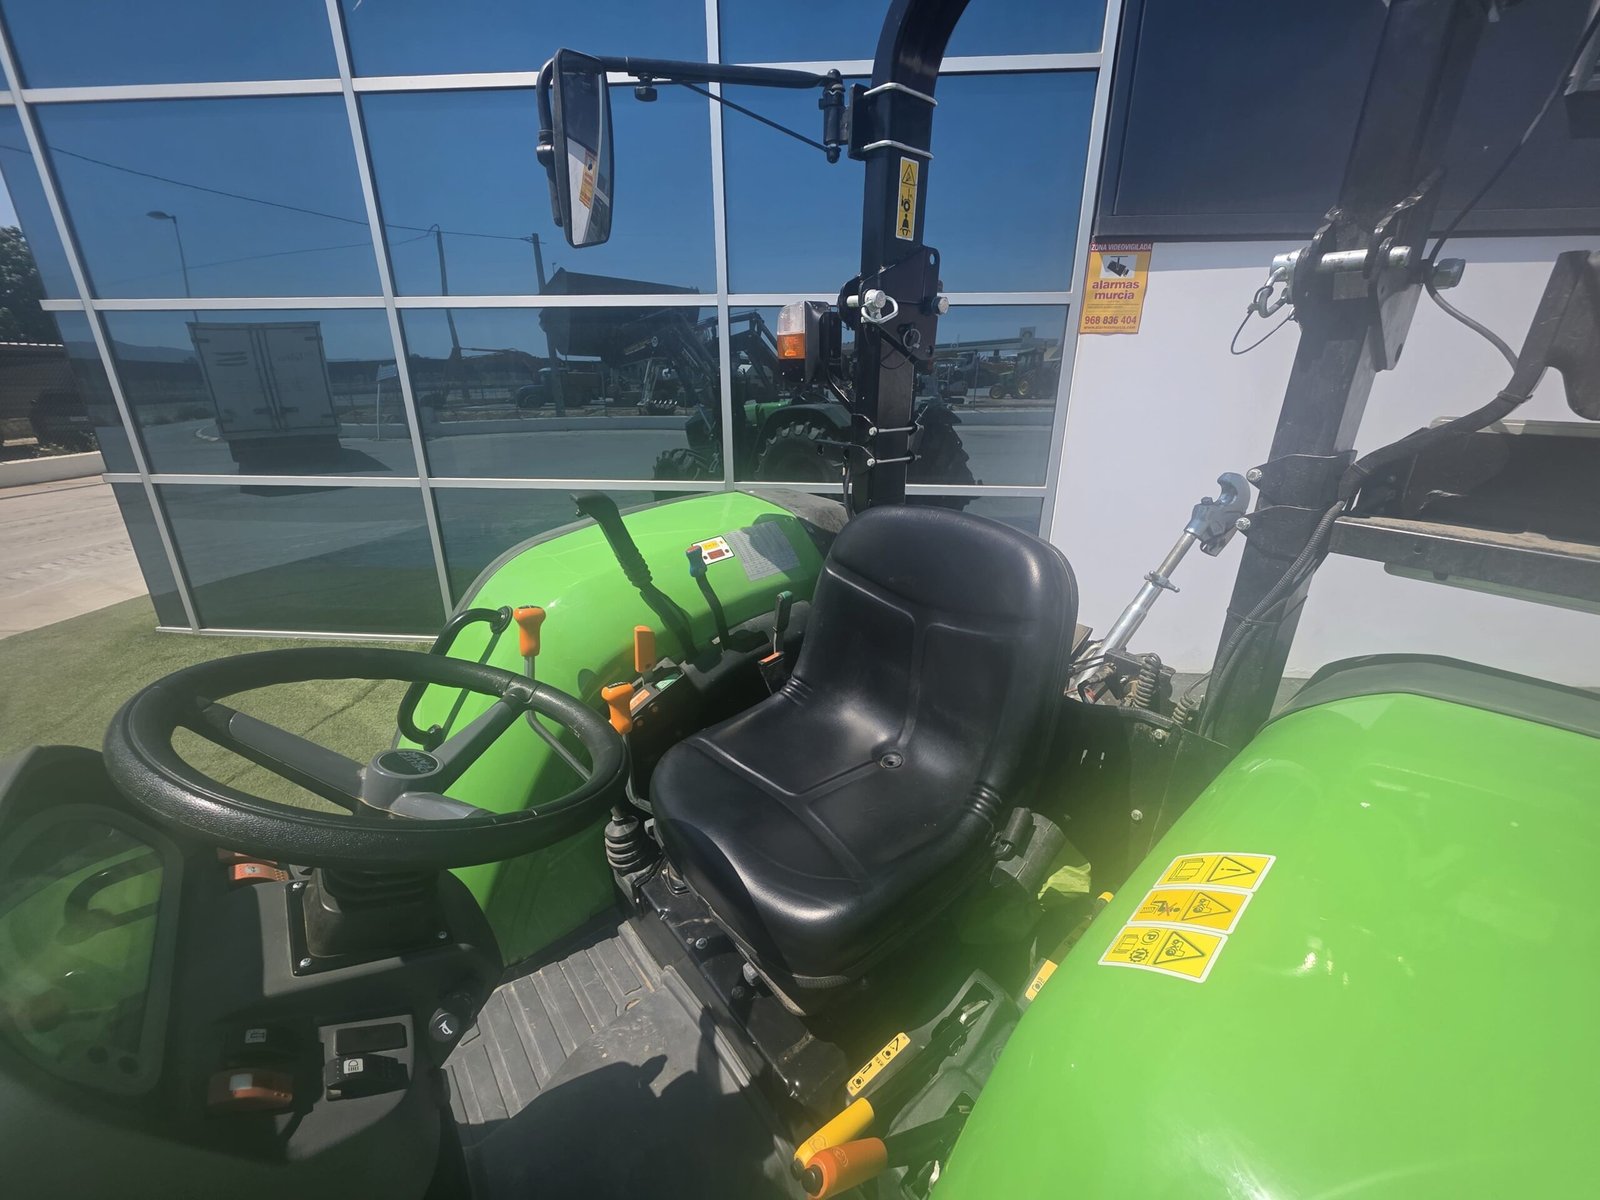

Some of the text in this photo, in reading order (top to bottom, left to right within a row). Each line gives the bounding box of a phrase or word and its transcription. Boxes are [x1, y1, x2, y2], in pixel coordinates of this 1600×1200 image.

[1091, 243, 1107, 251] ZONA
[1092, 280, 1140, 290] alarmas
[1094, 290, 1135, 300] murcia
[1085, 315, 1137, 325] 968 836 404
